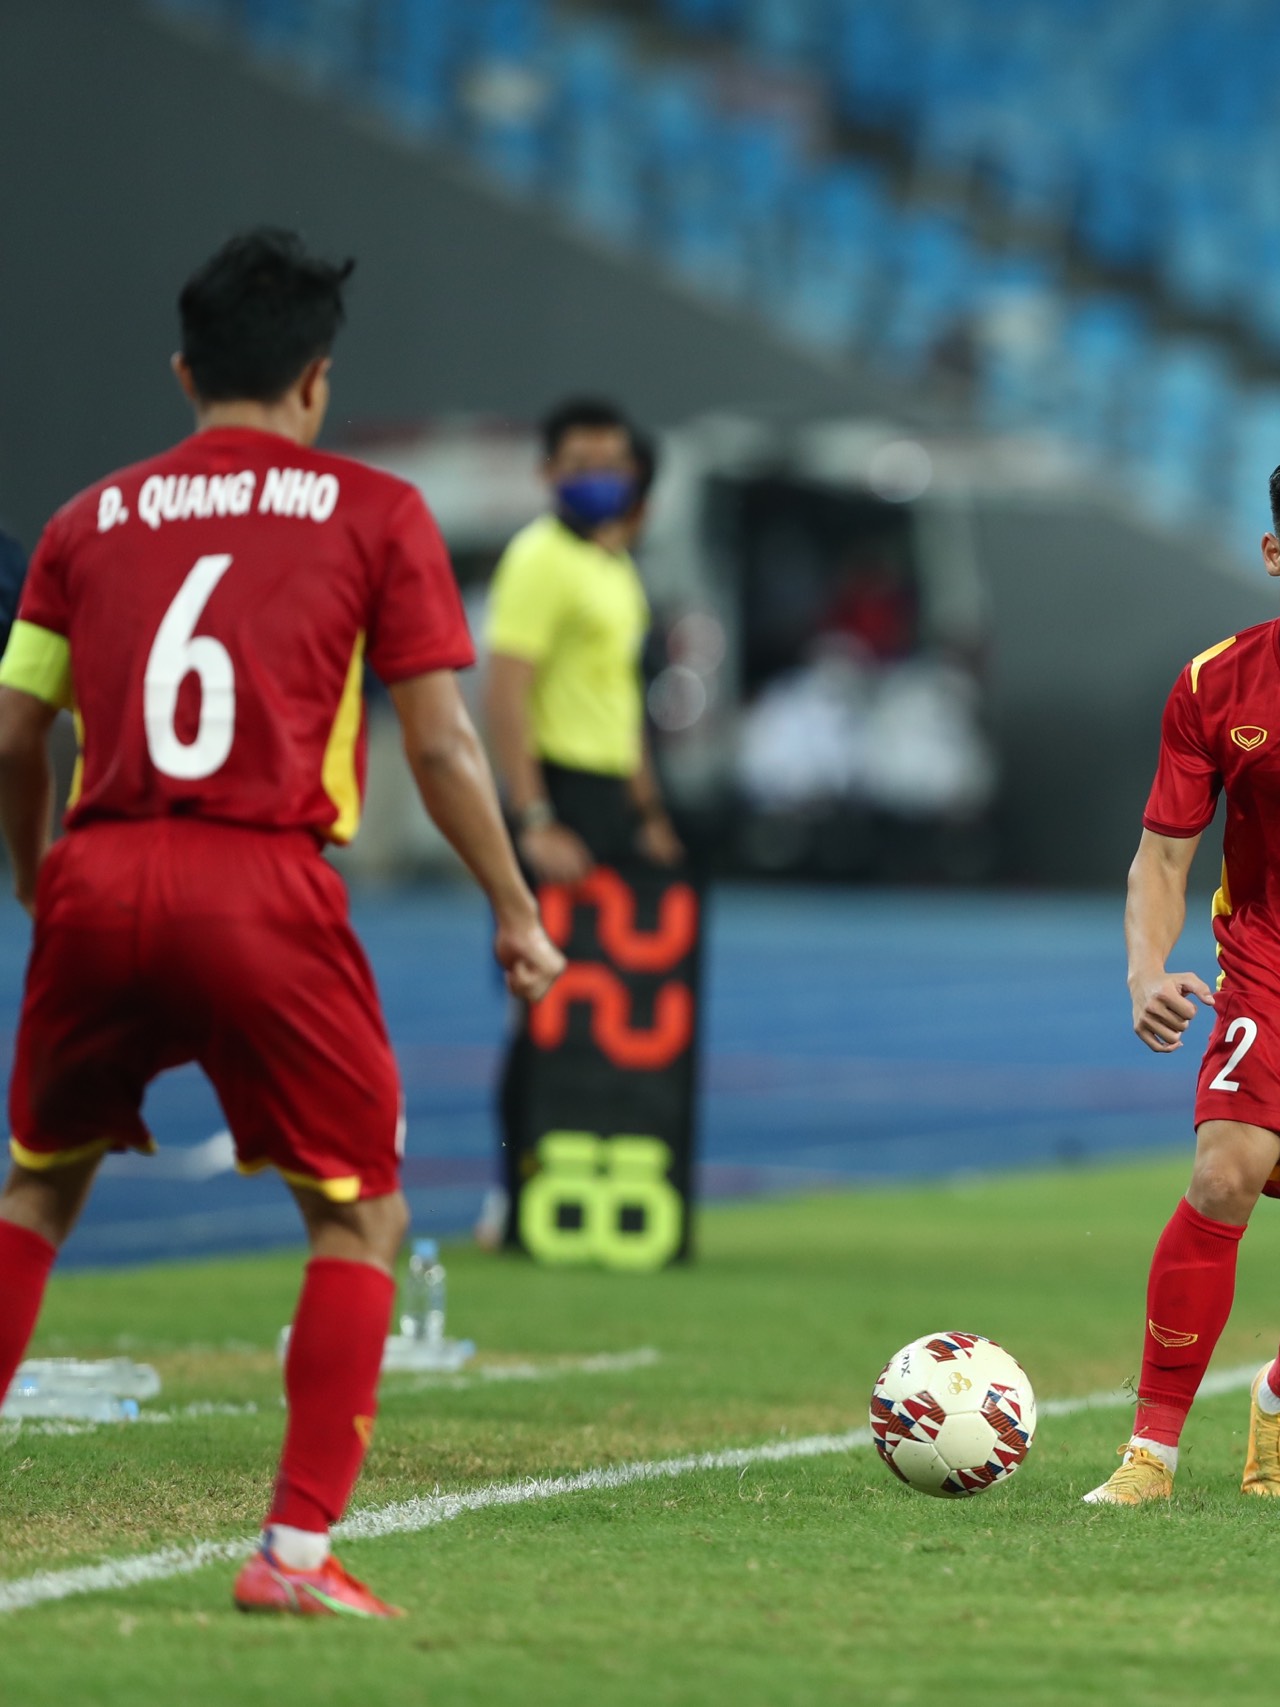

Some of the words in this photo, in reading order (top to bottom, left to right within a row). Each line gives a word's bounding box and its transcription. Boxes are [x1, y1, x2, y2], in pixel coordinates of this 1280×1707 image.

[138, 470, 256, 531] QUANG
[258, 467, 340, 523] NHO
[144, 553, 235, 780] 6
[1209, 1016, 1257, 1092] 2
